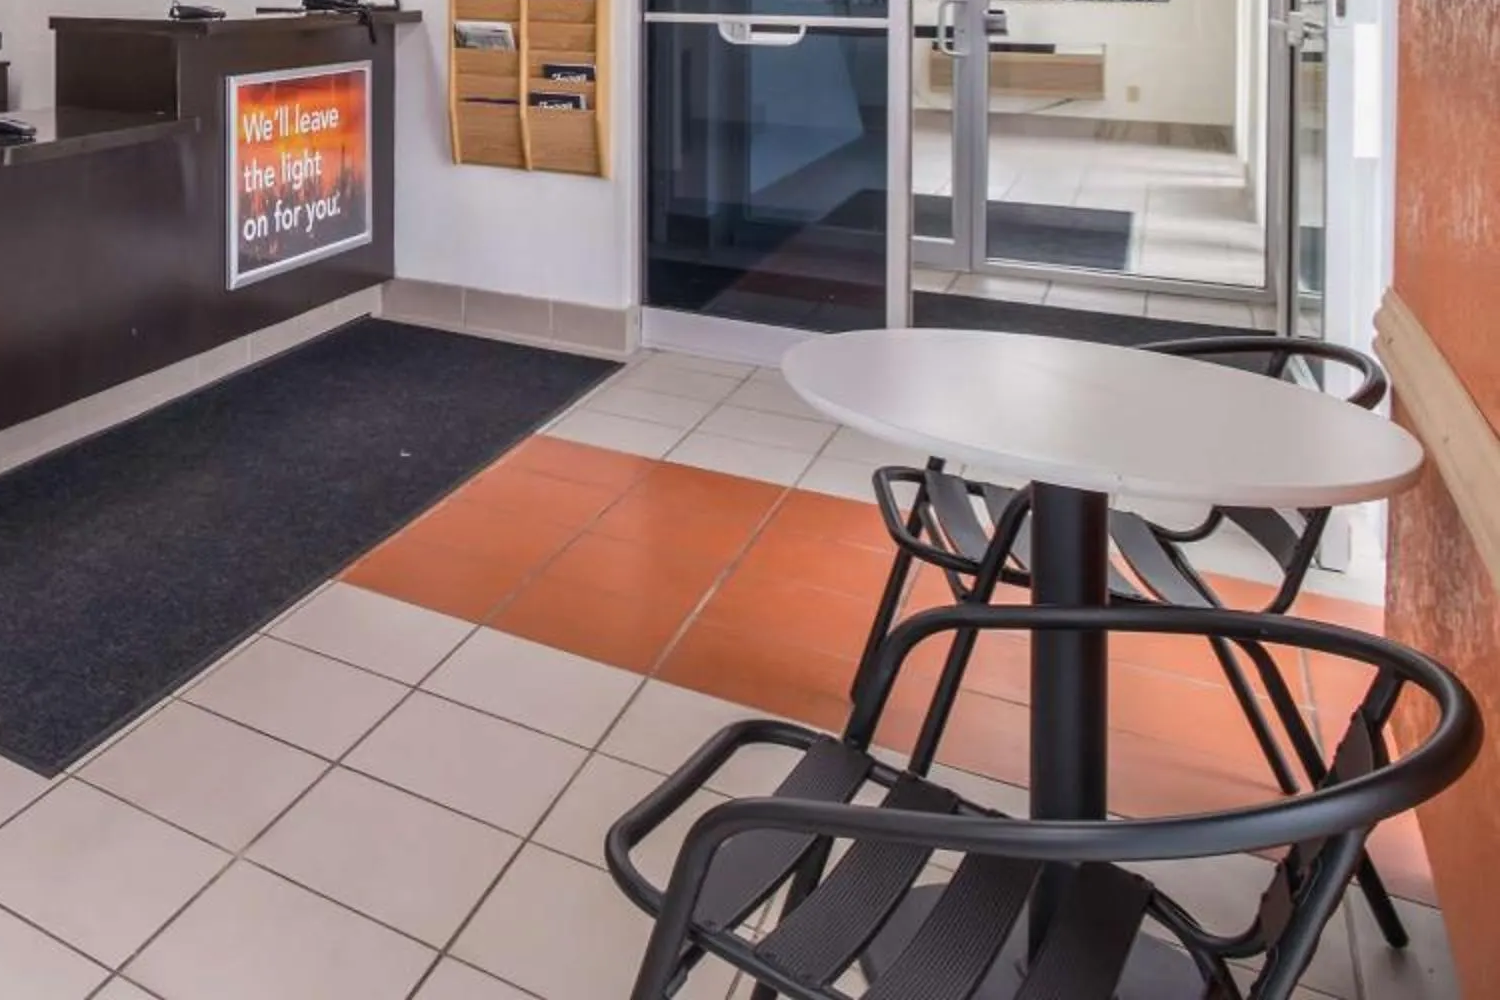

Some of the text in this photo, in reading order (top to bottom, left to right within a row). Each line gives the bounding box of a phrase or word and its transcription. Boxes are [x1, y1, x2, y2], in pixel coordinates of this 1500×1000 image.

[243, 103, 339, 144] We'll leave
[243, 149, 323, 193] the light
[243, 215, 269, 241] on
[274, 199, 302, 233] for
